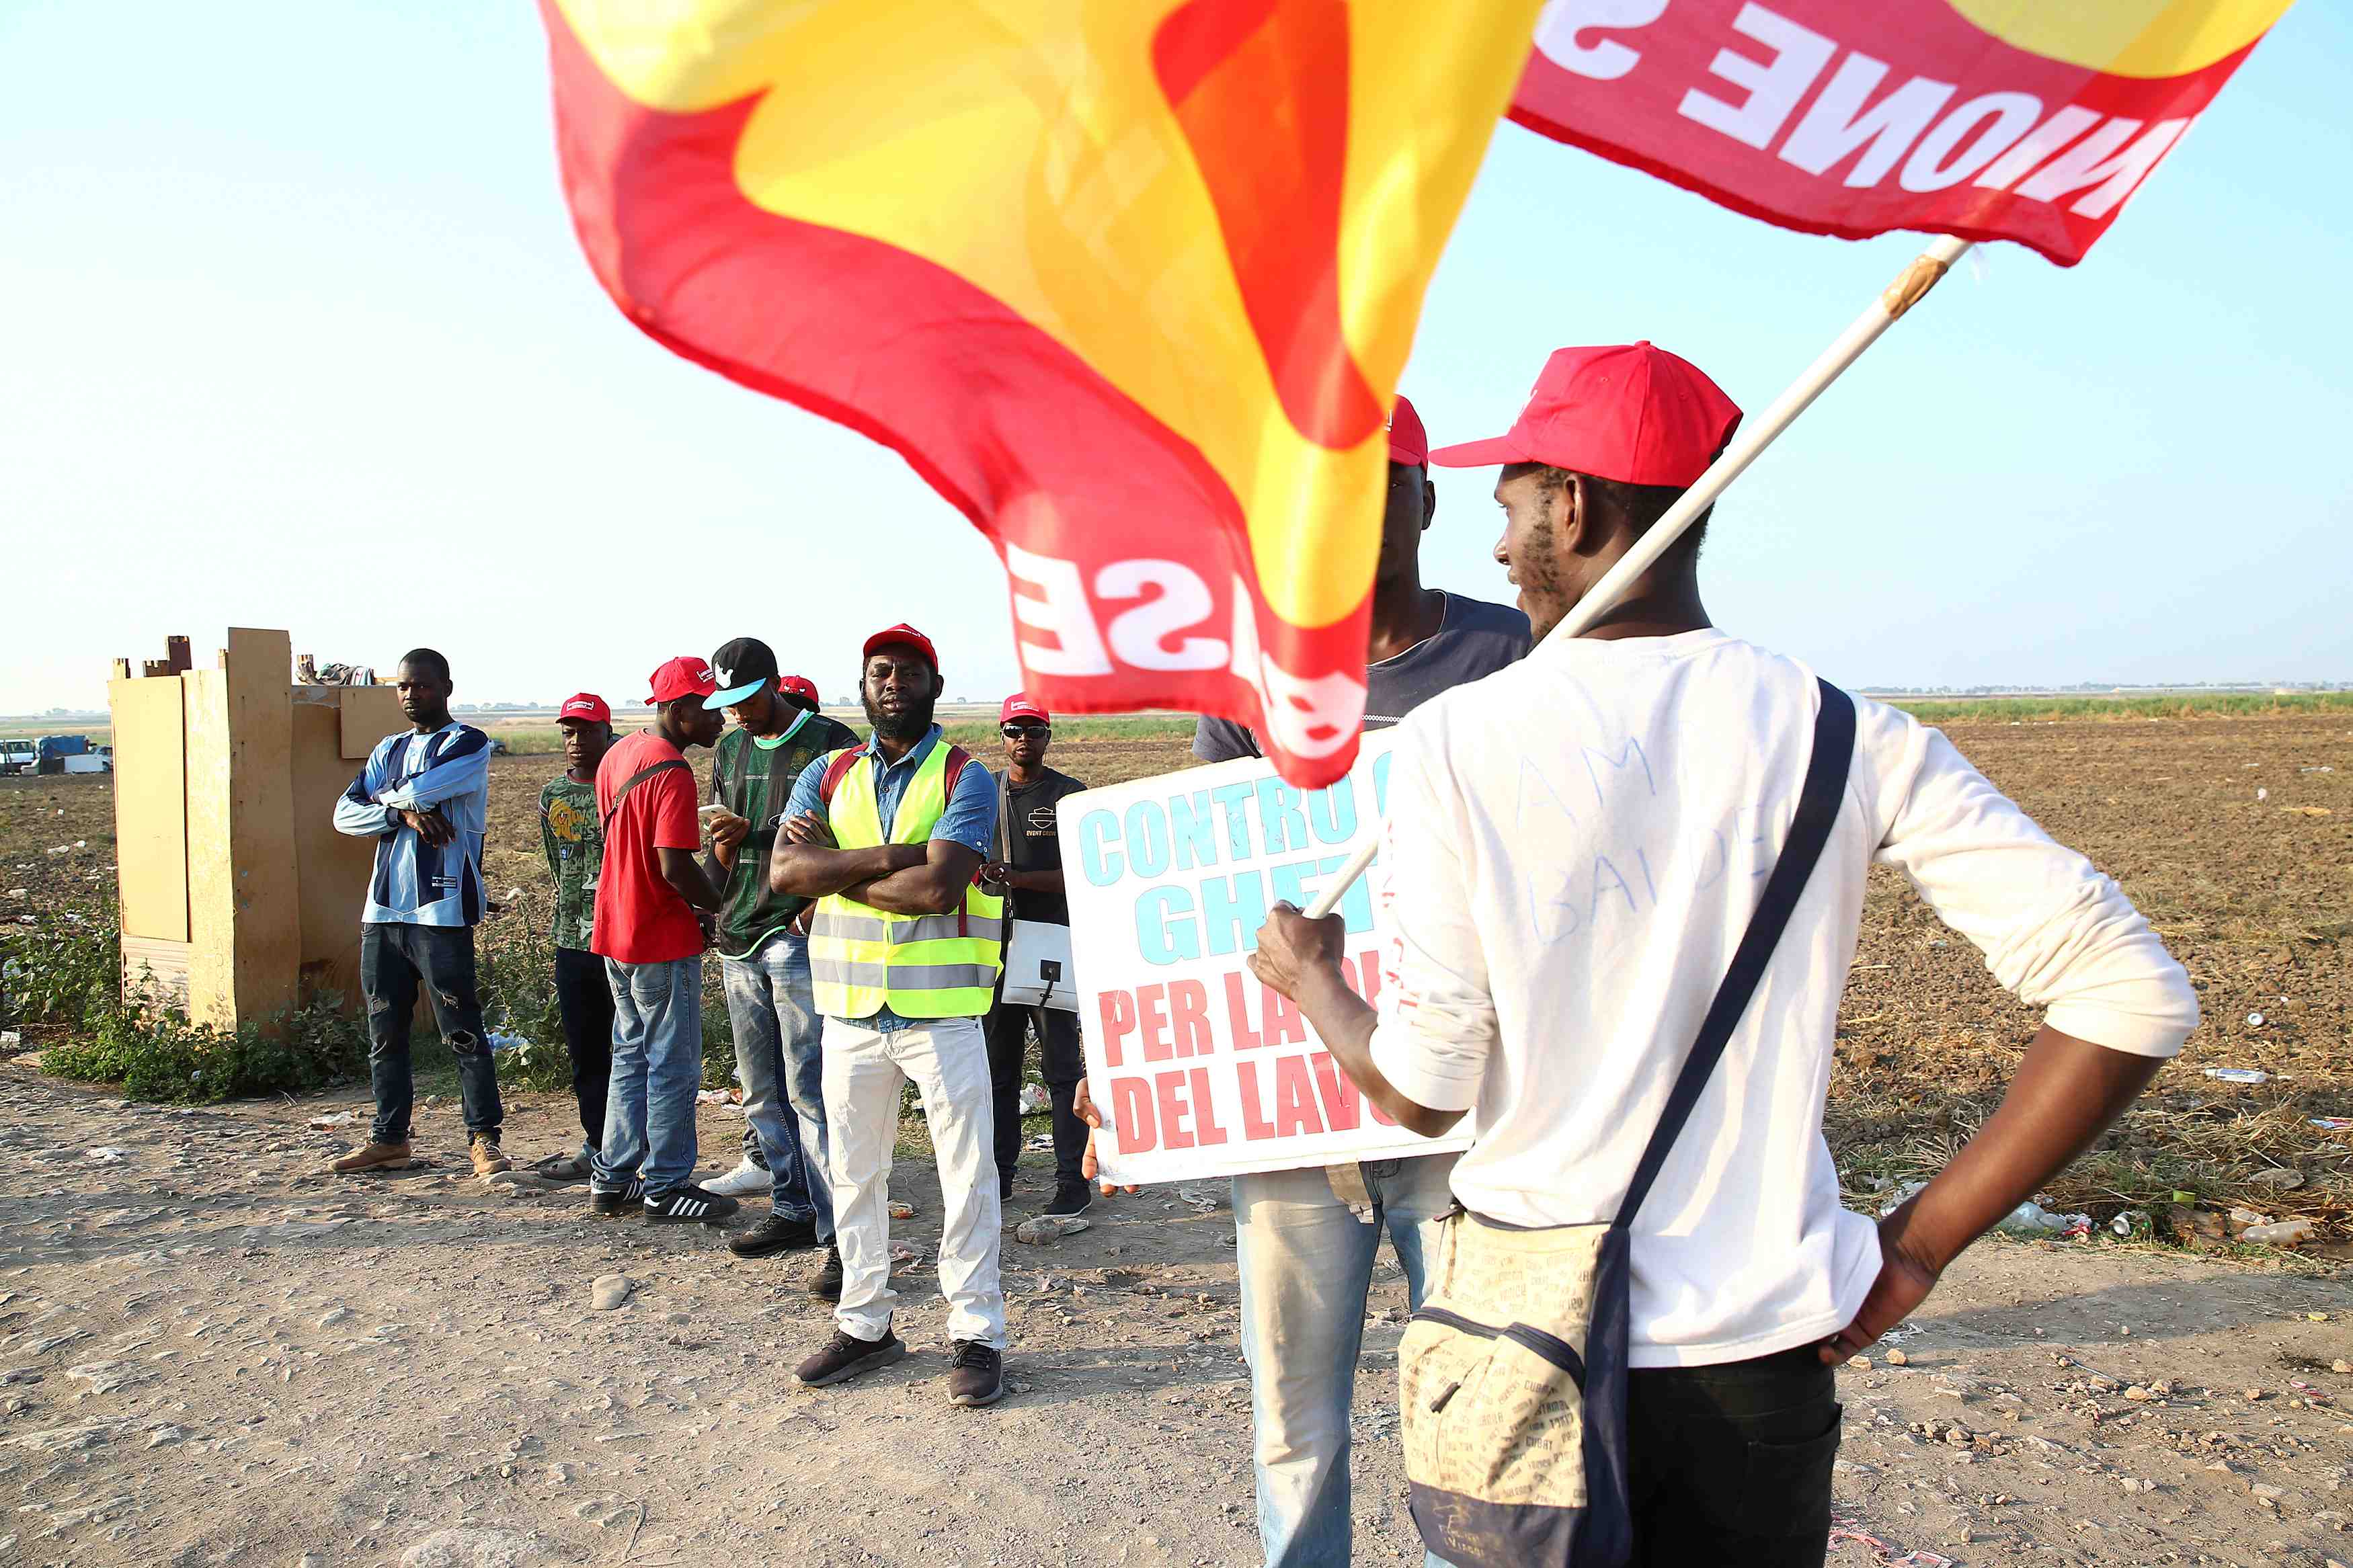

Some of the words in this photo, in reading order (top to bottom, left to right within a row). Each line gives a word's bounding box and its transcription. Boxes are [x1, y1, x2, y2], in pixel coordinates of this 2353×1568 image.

[1078, 772, 1358, 886] CONTRO
[1098, 978, 1214, 1067] PER
[1224, 971, 1306, 1050] LA
[1111, 1067, 1227, 1155] DEL
[1237, 1051, 1398, 1141] LAV
